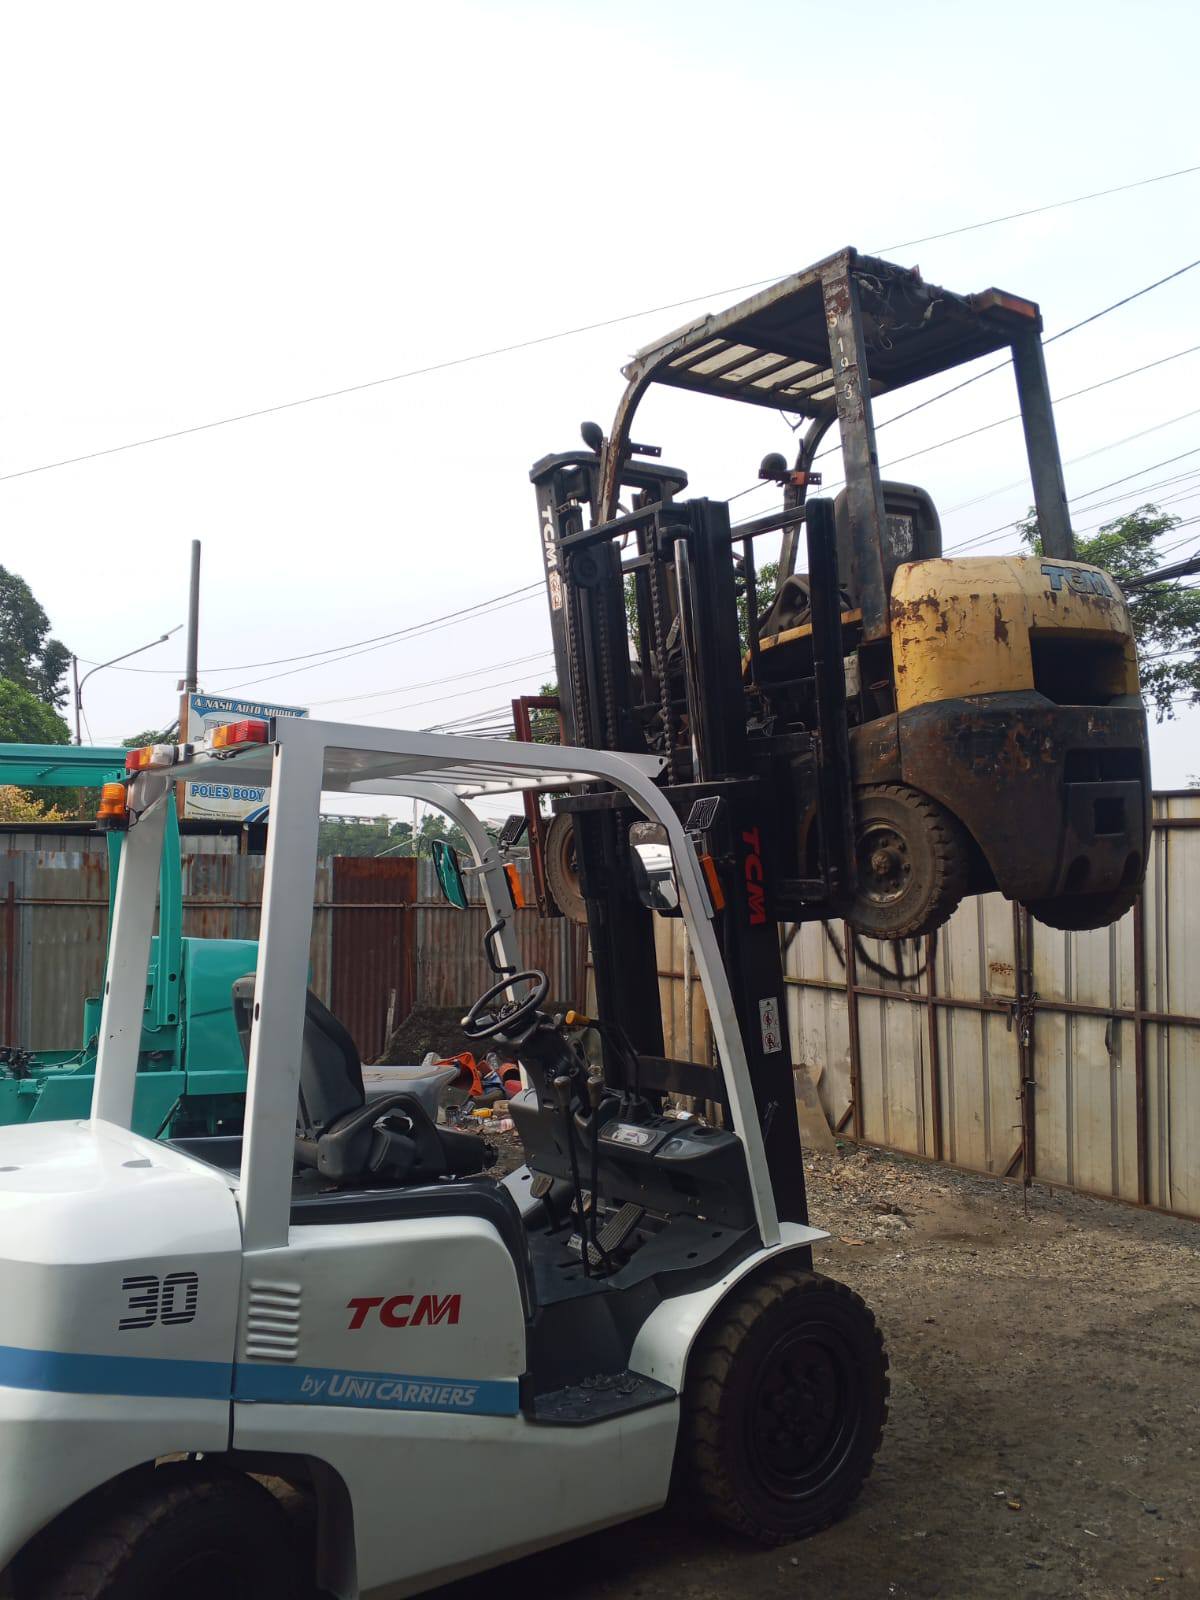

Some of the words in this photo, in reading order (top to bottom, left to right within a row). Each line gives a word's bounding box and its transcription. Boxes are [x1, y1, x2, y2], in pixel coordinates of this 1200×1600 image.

[541, 504, 558, 568] TCM
[236, 704, 262, 716] AUTO
[191, 784, 231, 799] POLES
[232, 788, 265, 802] BODY
[742, 827, 766, 925] TCM
[118, 1271, 199, 1331] 30
[346, 1294, 461, 1330] TCM
[301, 1375, 328, 1398] by
